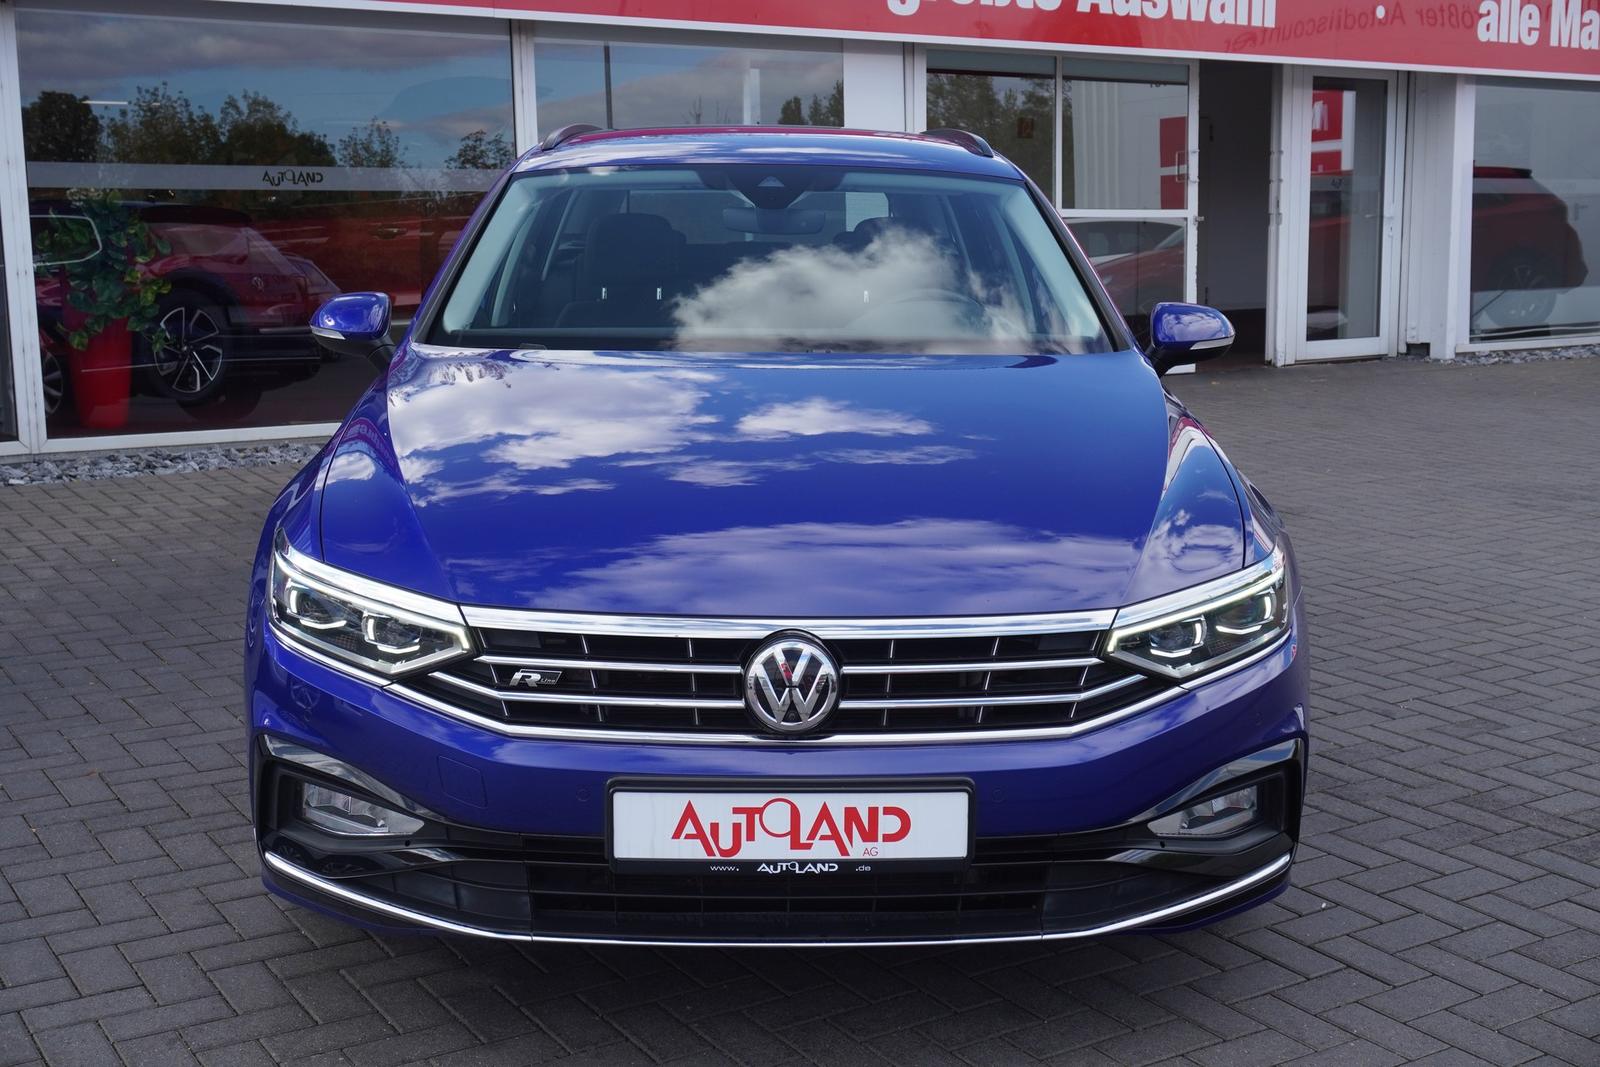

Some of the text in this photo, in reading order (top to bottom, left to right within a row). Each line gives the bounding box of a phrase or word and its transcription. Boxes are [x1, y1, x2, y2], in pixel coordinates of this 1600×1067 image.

[1477, 0, 1540, 45] alle
[262, 169, 323, 186] AUTOLAND
[510, 671, 541, 687] R
[749, 642, 837, 730] VW
[671, 797, 911, 858] AUTOLAND
[863, 847, 879, 857] AG
[757, 862, 838, 874] AUTOLAND
[855, 864, 871, 872] .de
